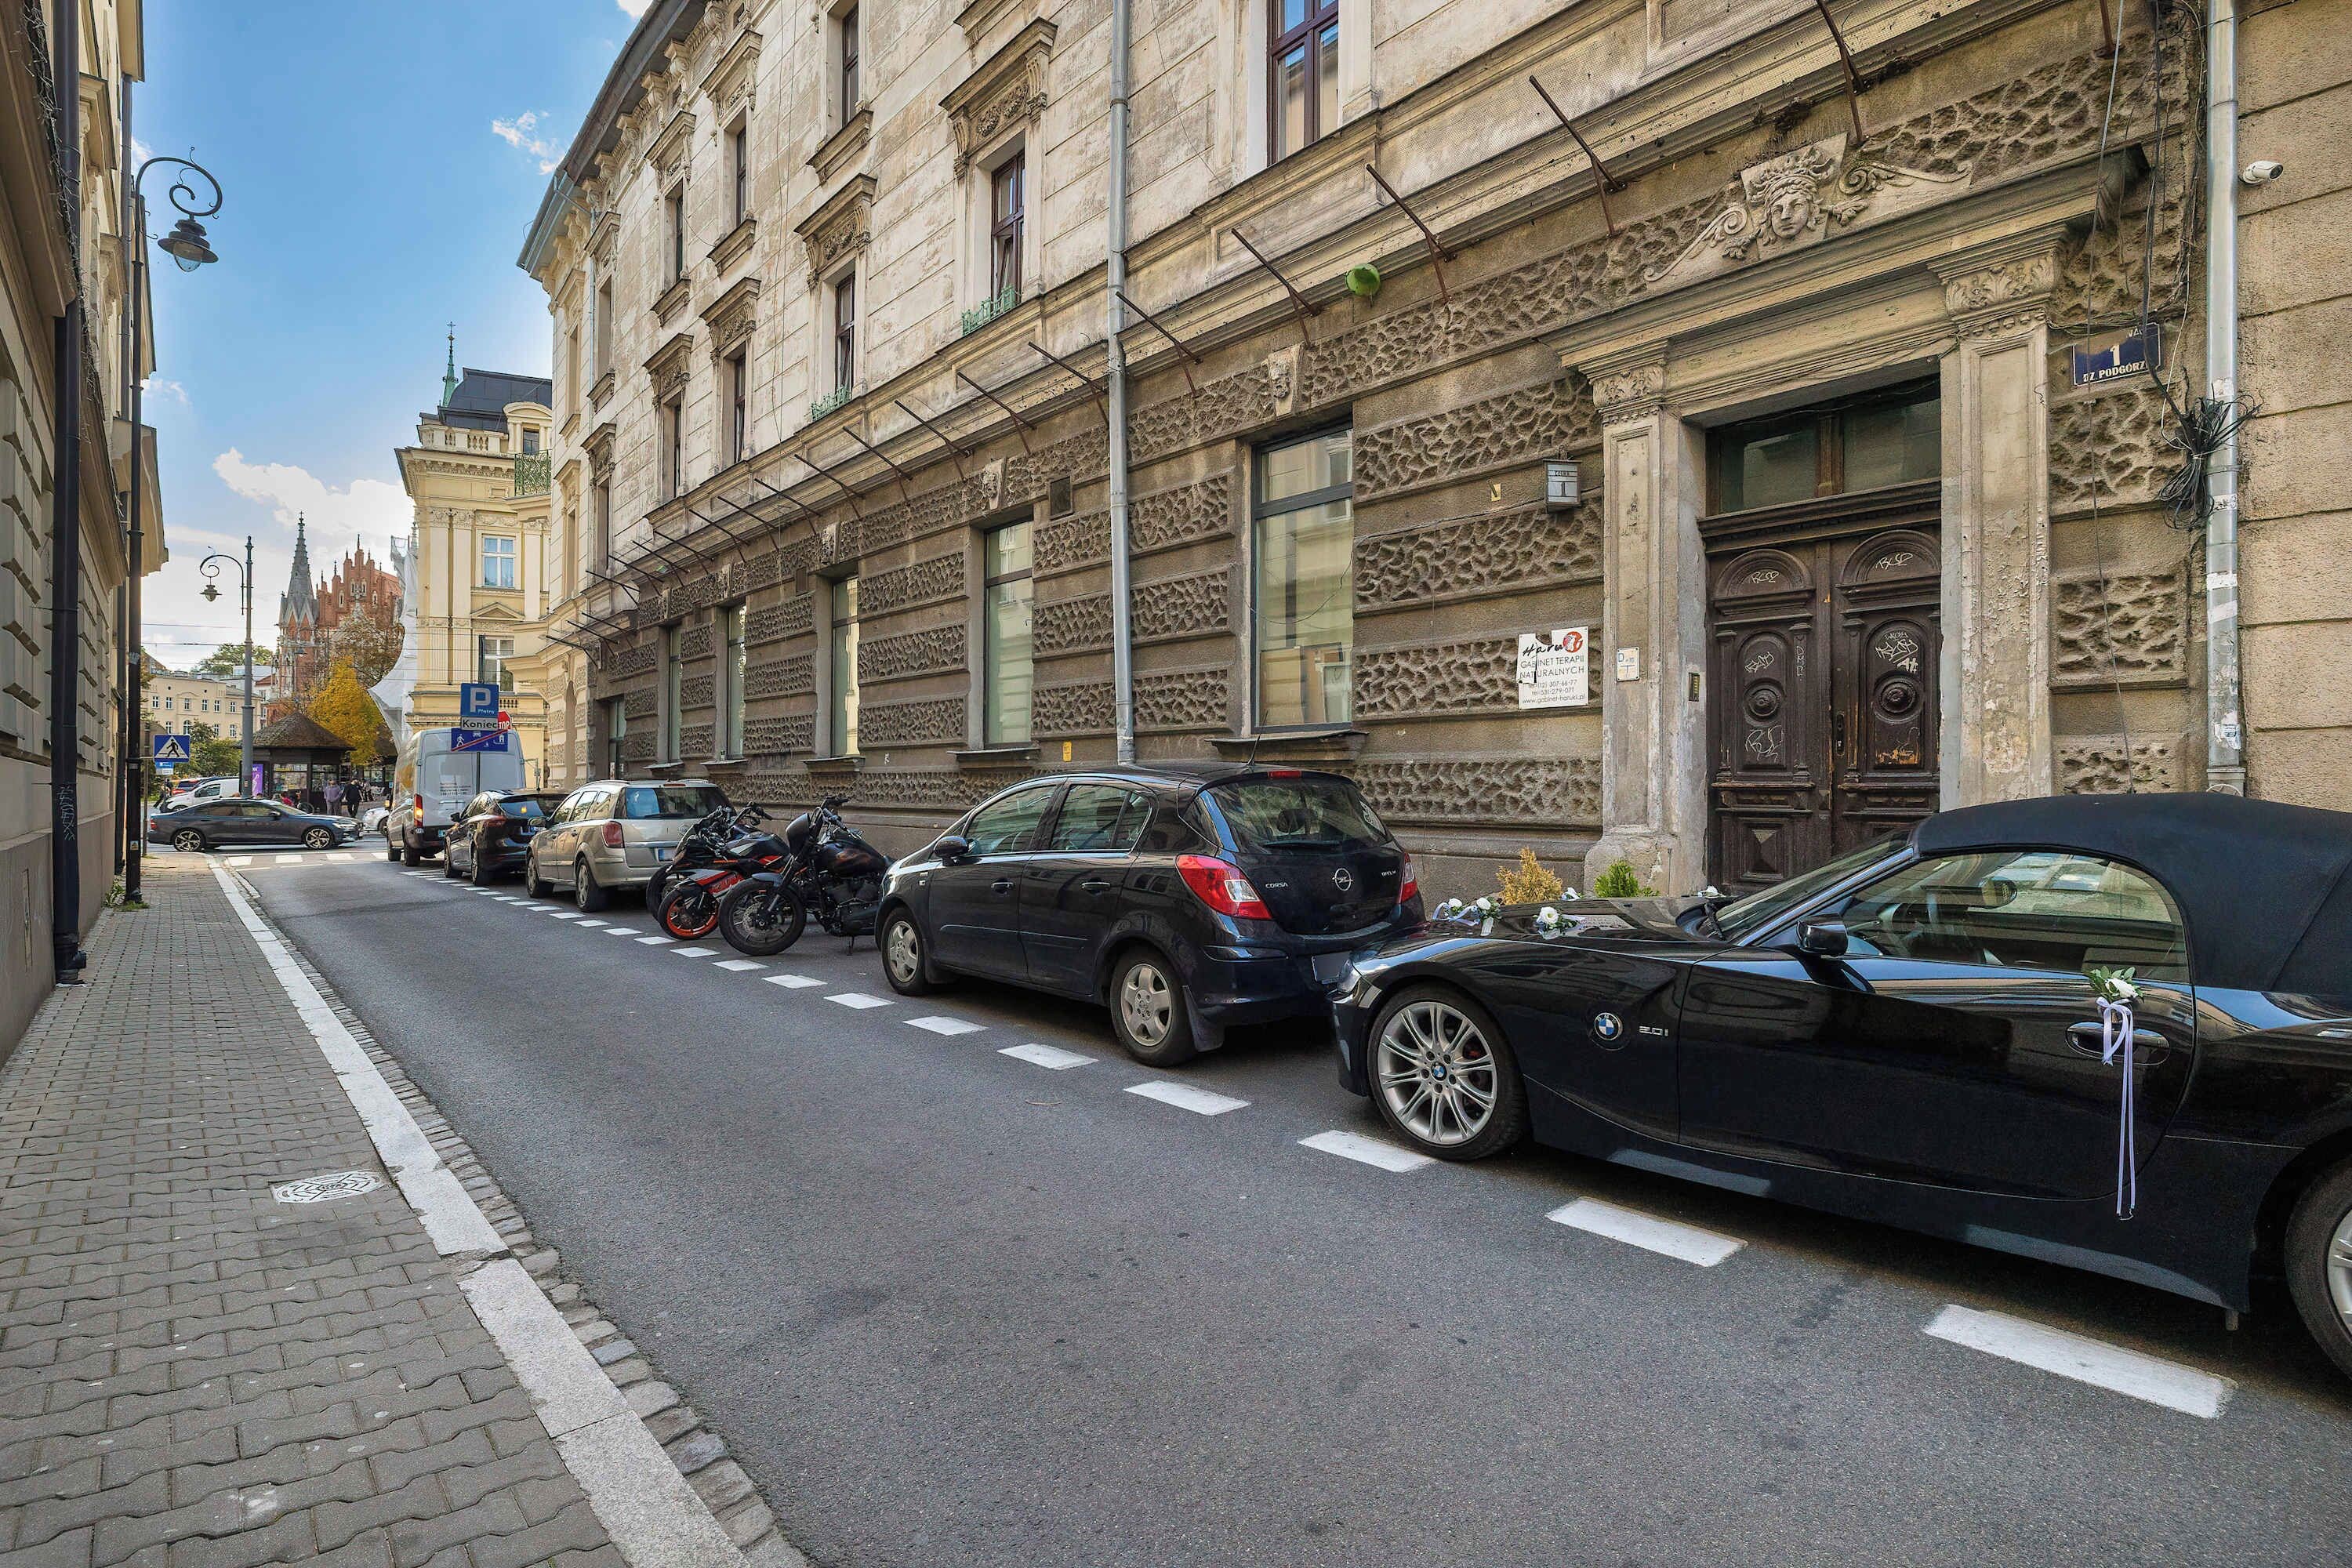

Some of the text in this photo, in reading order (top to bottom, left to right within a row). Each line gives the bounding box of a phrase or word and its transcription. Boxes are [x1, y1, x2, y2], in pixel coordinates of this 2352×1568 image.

[2110, 345, 2121, 366] 1
[2098, 361, 2148, 379] PODGÓRZ
[1556, 655, 1584, 666] TERAPII
[470, 687, 491, 713] P
[463, 720, 498, 728] Koniec
[498, 721, 510, 730] TOP
